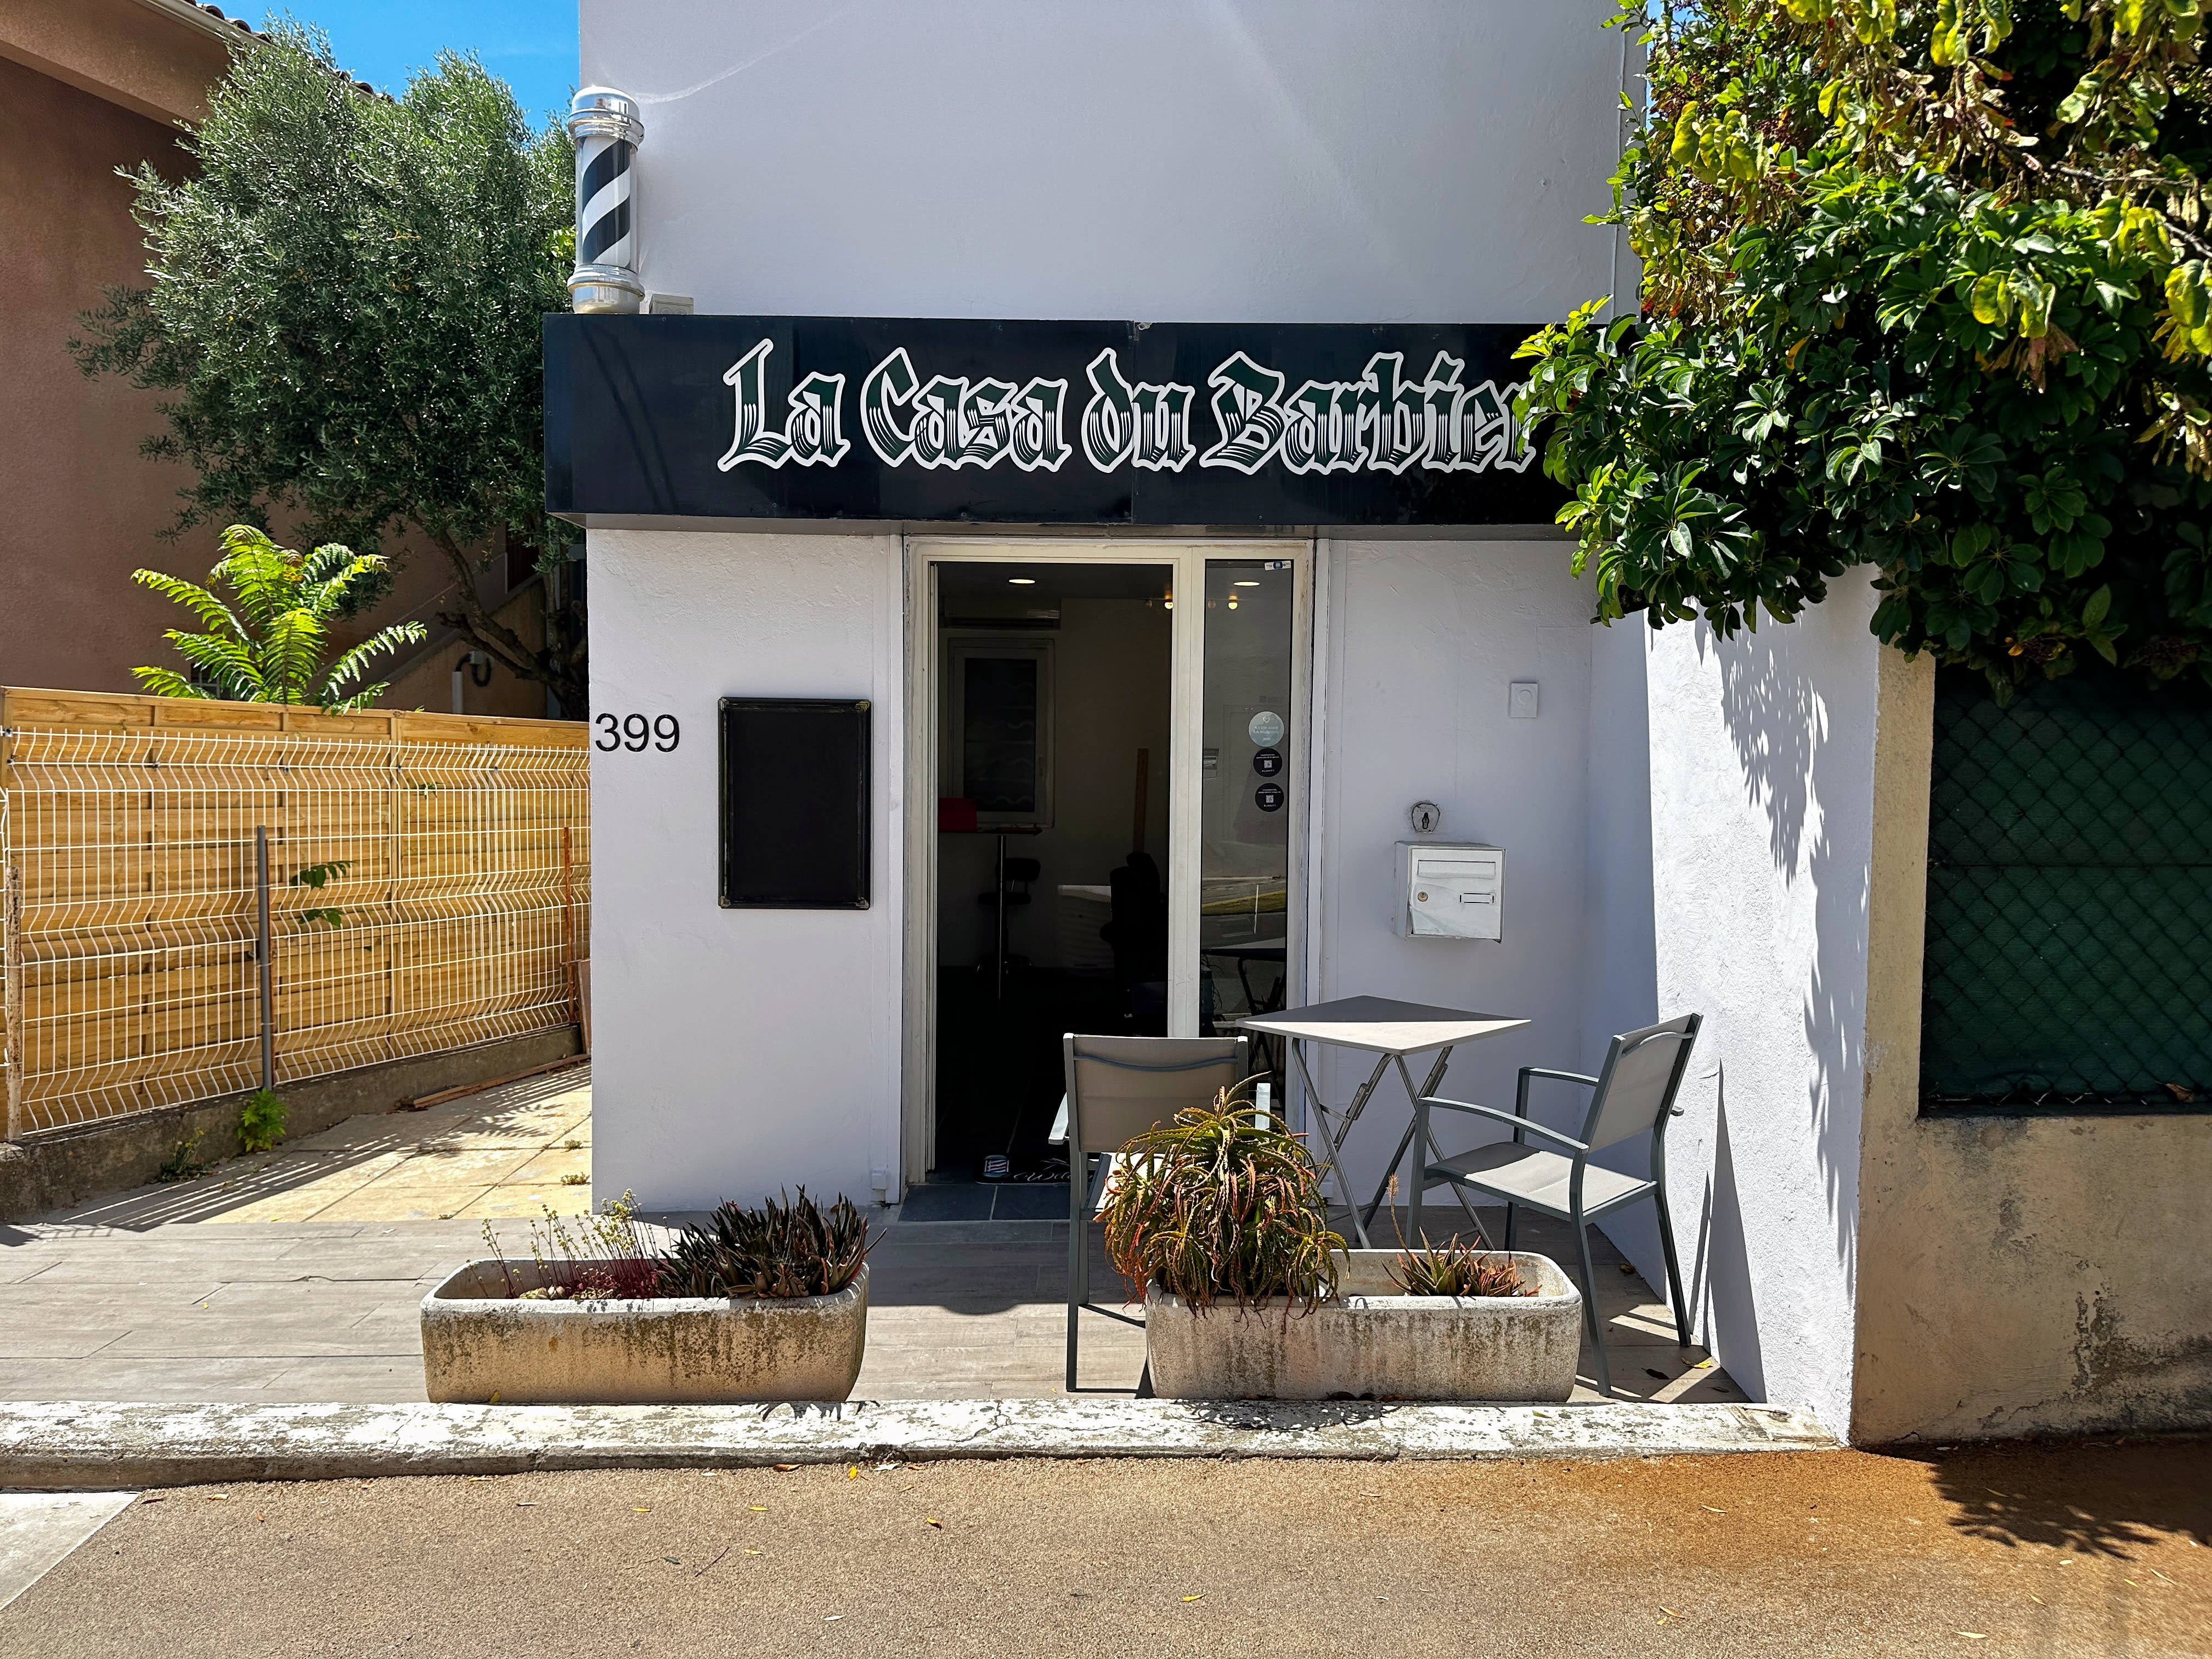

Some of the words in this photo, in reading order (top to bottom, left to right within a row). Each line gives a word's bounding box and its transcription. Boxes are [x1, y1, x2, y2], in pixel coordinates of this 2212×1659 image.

[717, 338, 850, 472] La
[860, 347, 1073, 473] Casa
[1081, 347, 1196, 473] du
[595, 713, 680, 752] 399
